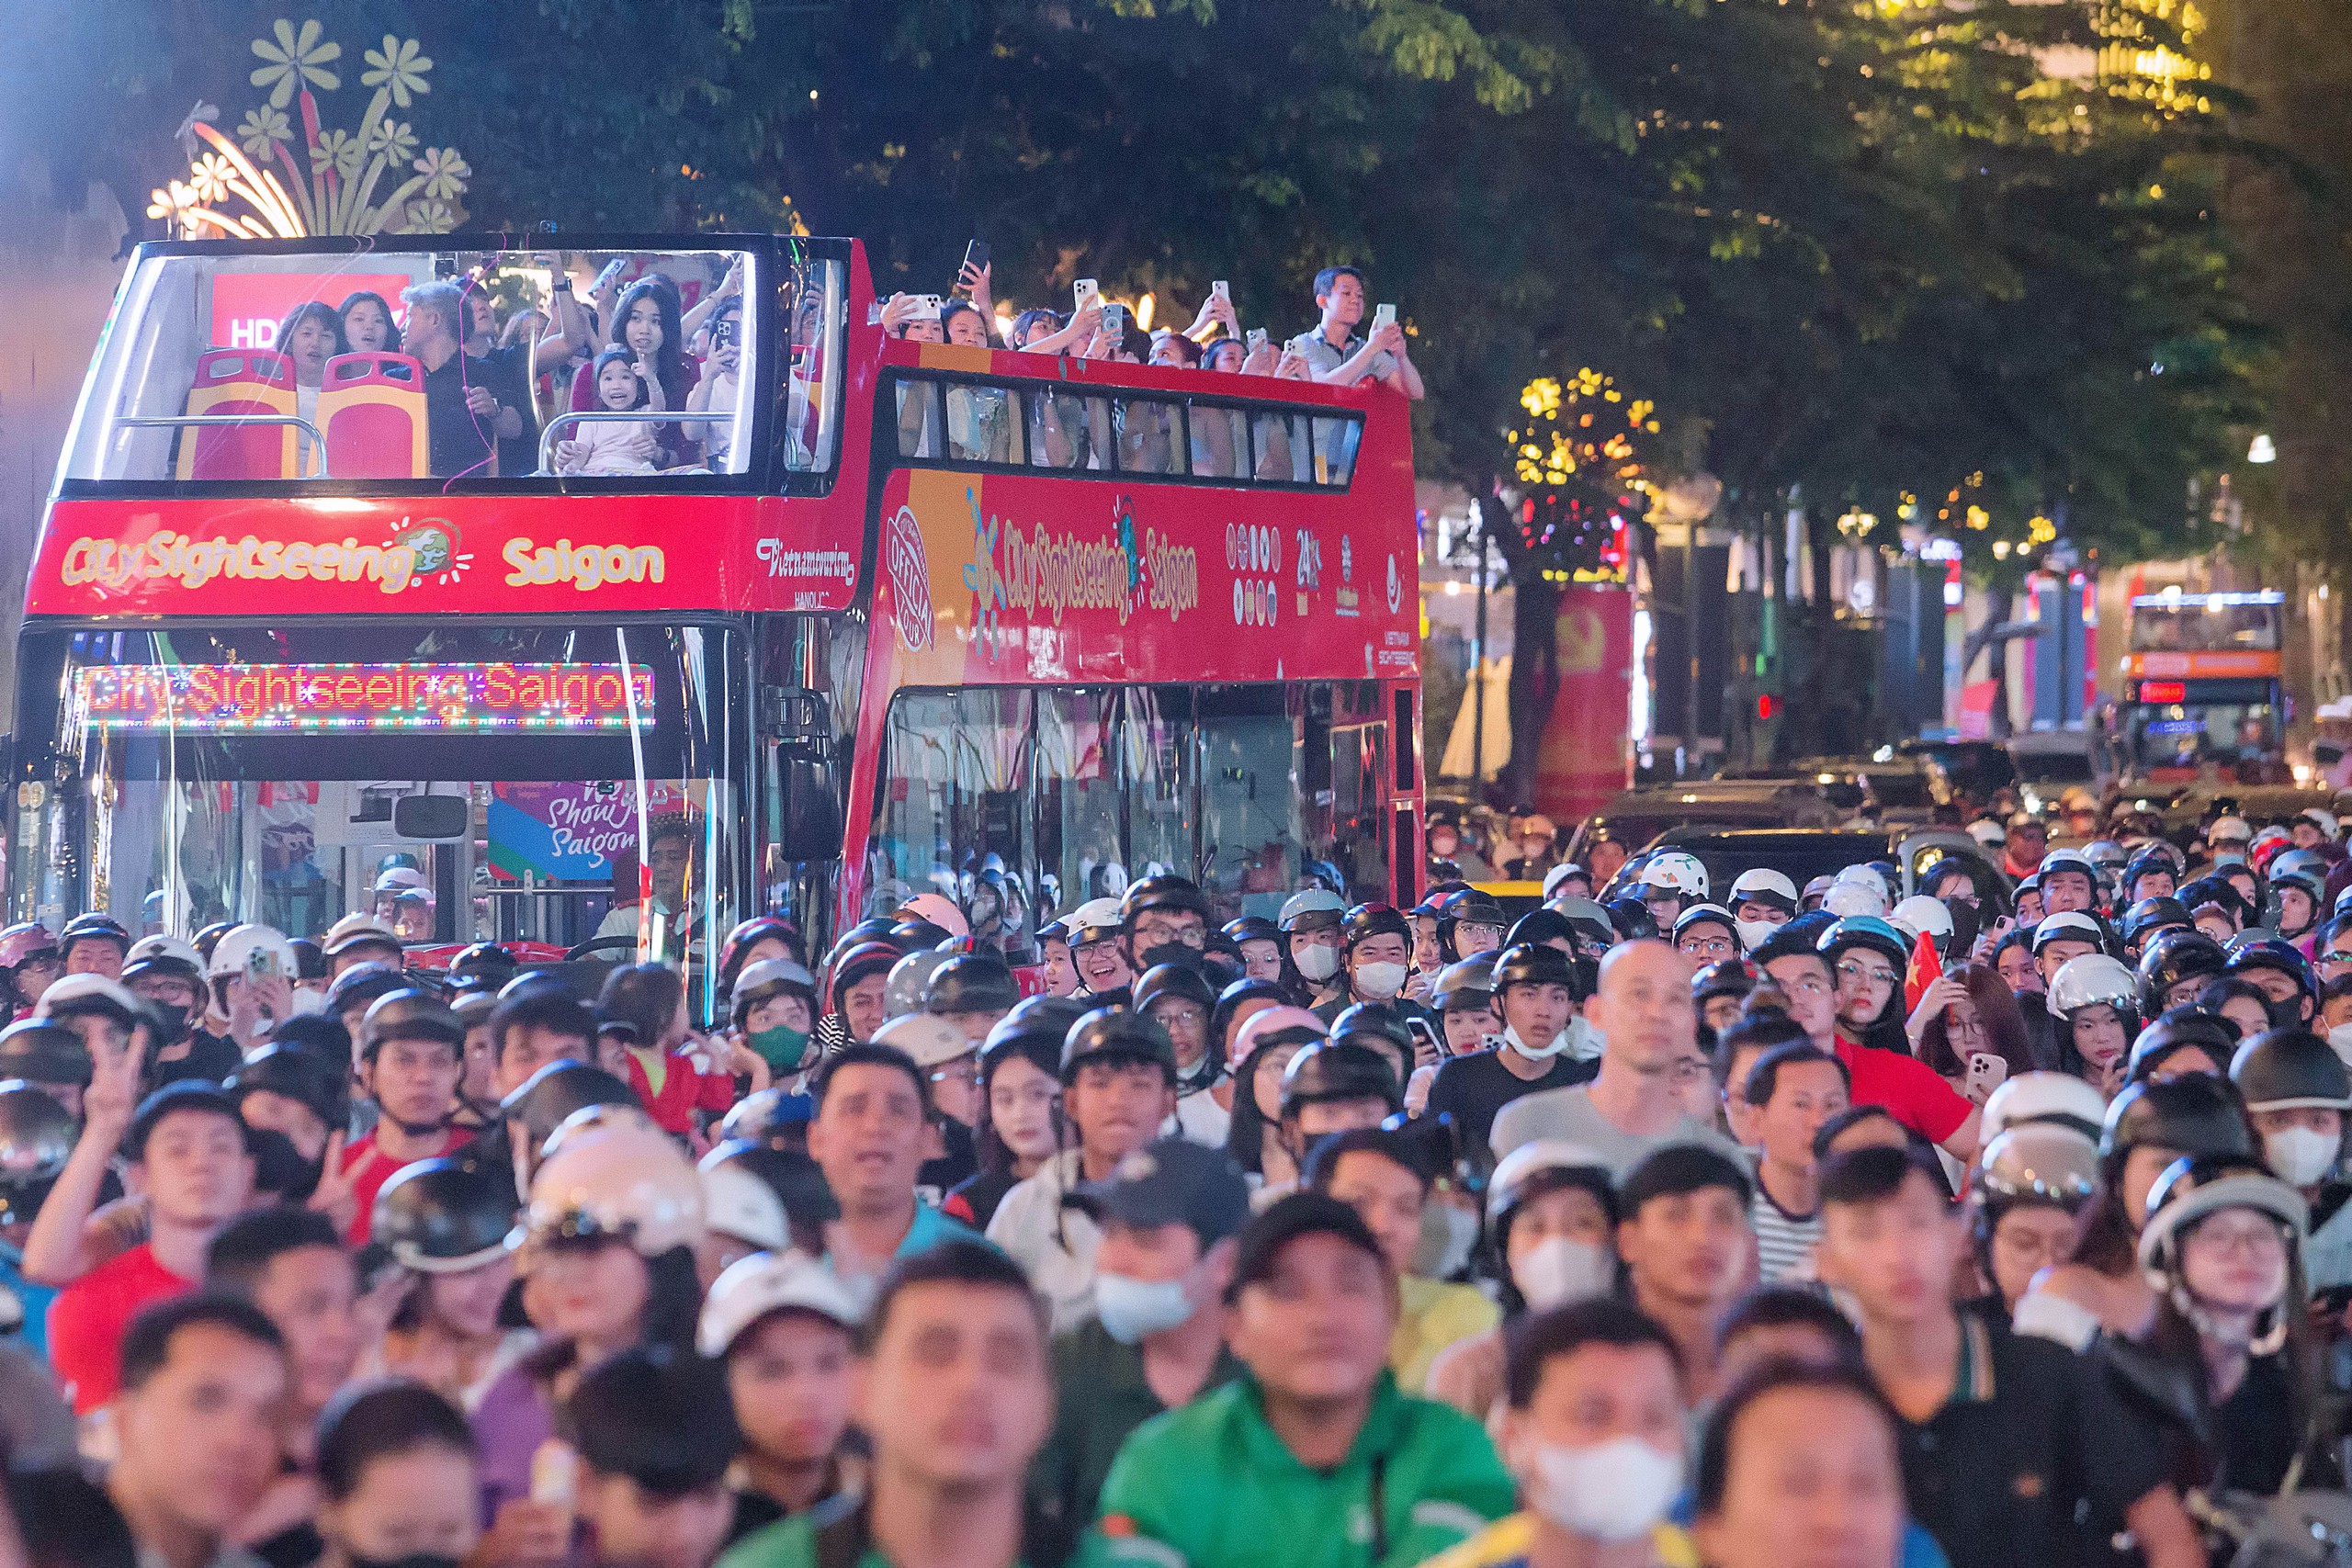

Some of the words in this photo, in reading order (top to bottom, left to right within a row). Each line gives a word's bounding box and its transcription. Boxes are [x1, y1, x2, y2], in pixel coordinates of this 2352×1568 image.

[231, 318, 285, 348] HD
[503, 537, 664, 591] Saigon
[891, 536, 932, 645] OFFICIAL
[1147, 527, 1198, 622] Saigon
[900, 595, 920, 645] TOUR
[83, 665, 167, 721] City
[187, 664, 465, 722] Sightseeing
[551, 828, 636, 869] Saigon
